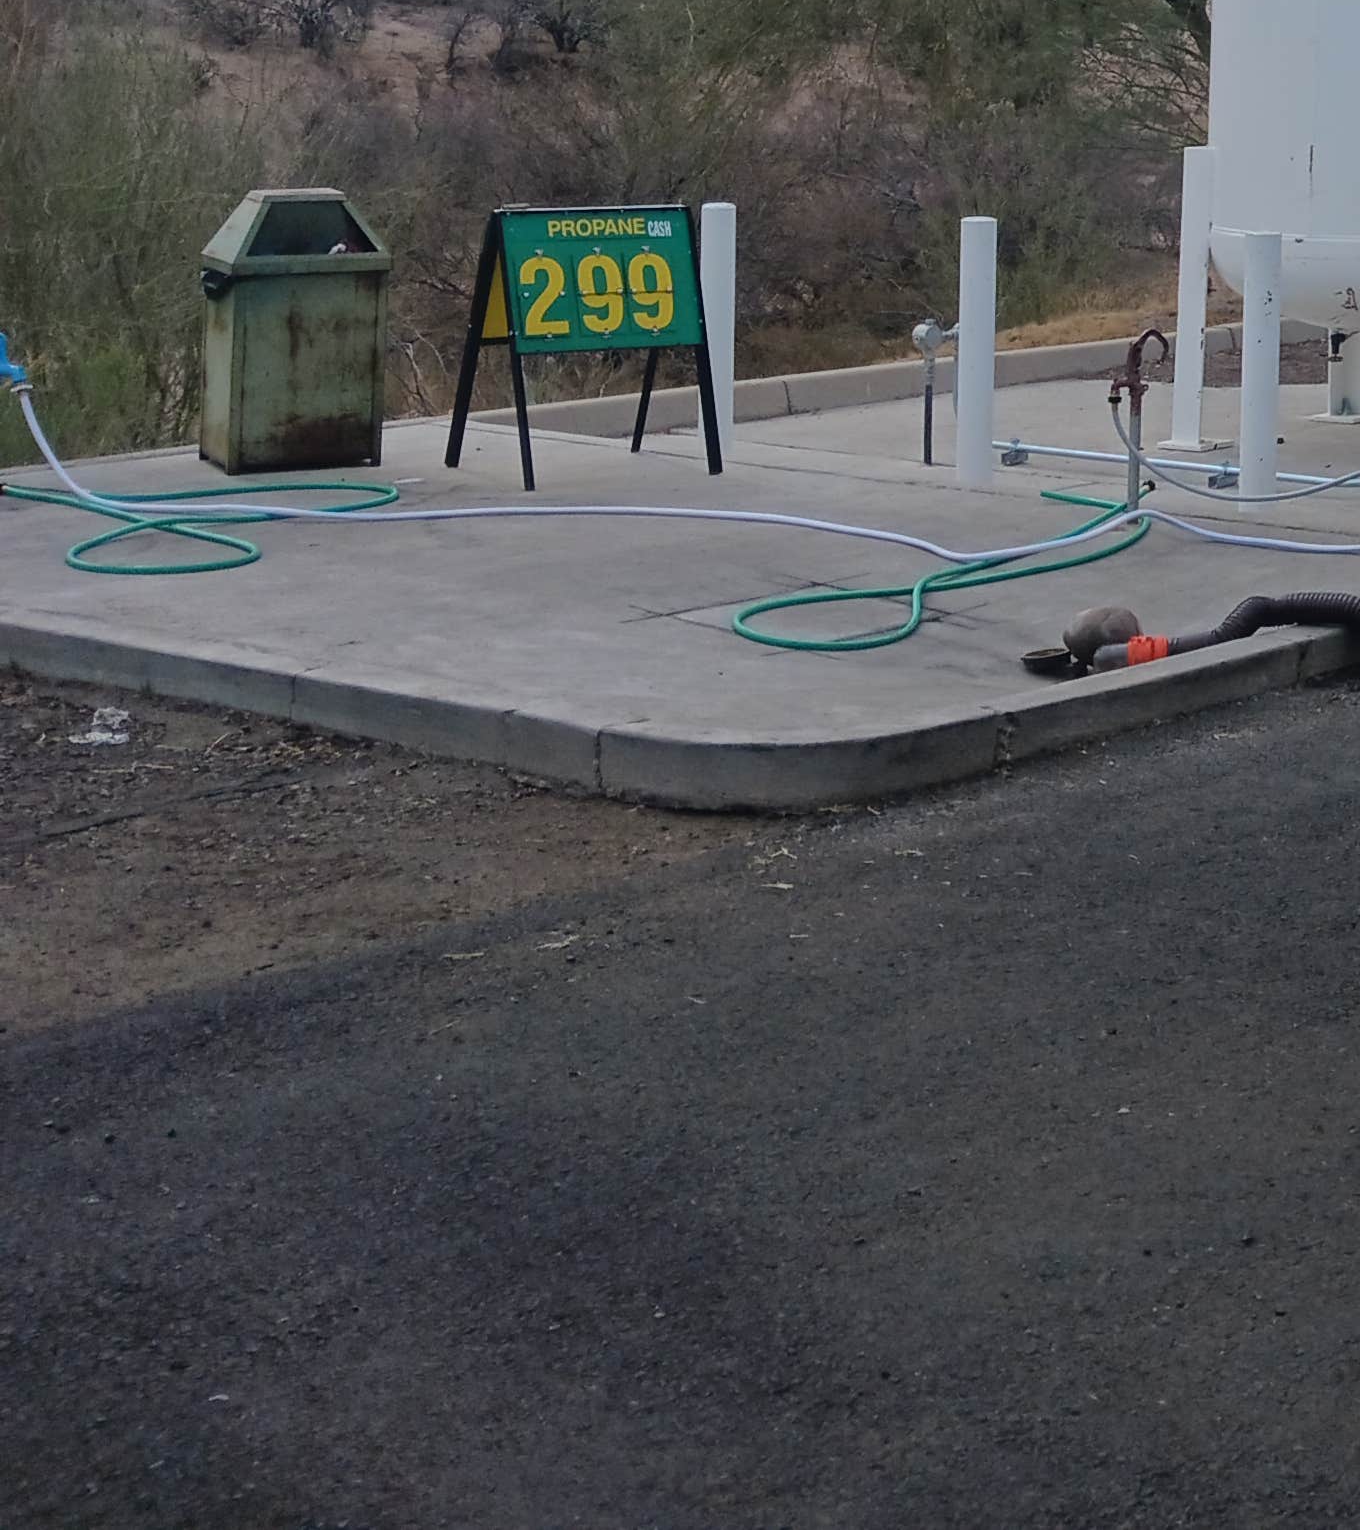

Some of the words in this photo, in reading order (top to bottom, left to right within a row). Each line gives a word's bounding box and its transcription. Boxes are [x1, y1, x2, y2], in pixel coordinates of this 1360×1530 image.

[547, 217, 646, 238] PROPANE
[647, 220, 672, 237] CASH
[519, 252, 675, 337] 299
